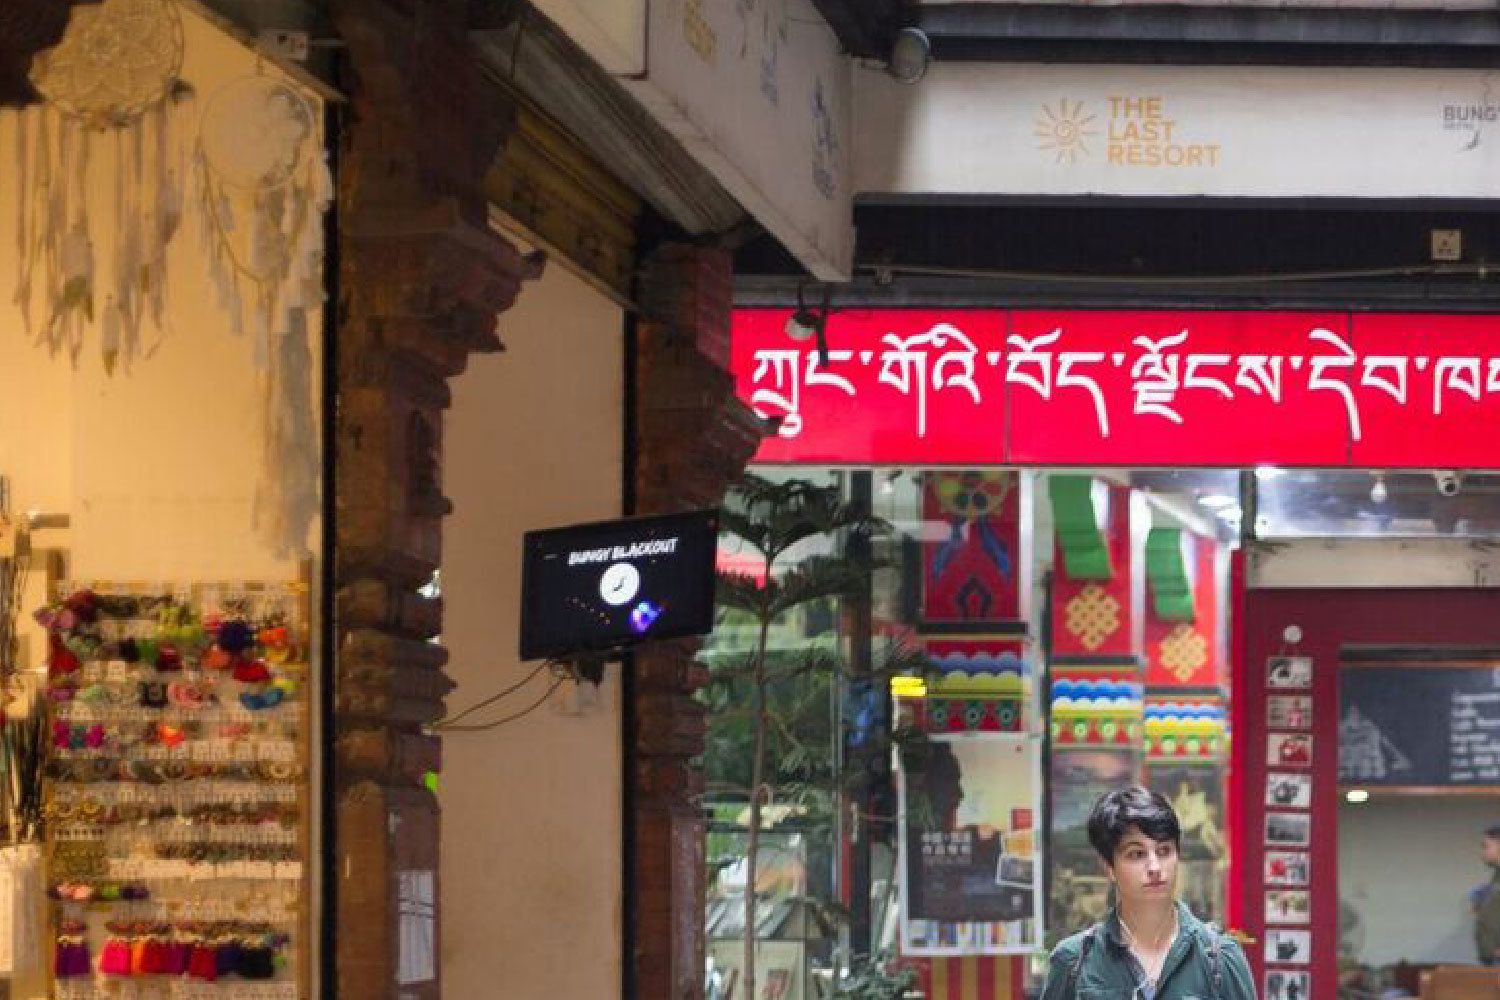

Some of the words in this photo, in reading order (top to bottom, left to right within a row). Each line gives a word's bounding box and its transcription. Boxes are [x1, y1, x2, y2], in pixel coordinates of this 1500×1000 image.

[1107, 96, 1163, 119] THE
[1107, 120, 1176, 141] LAST
[1107, 144, 1221, 167] RESORT
[612, 537, 678, 559] BLACKOUT
